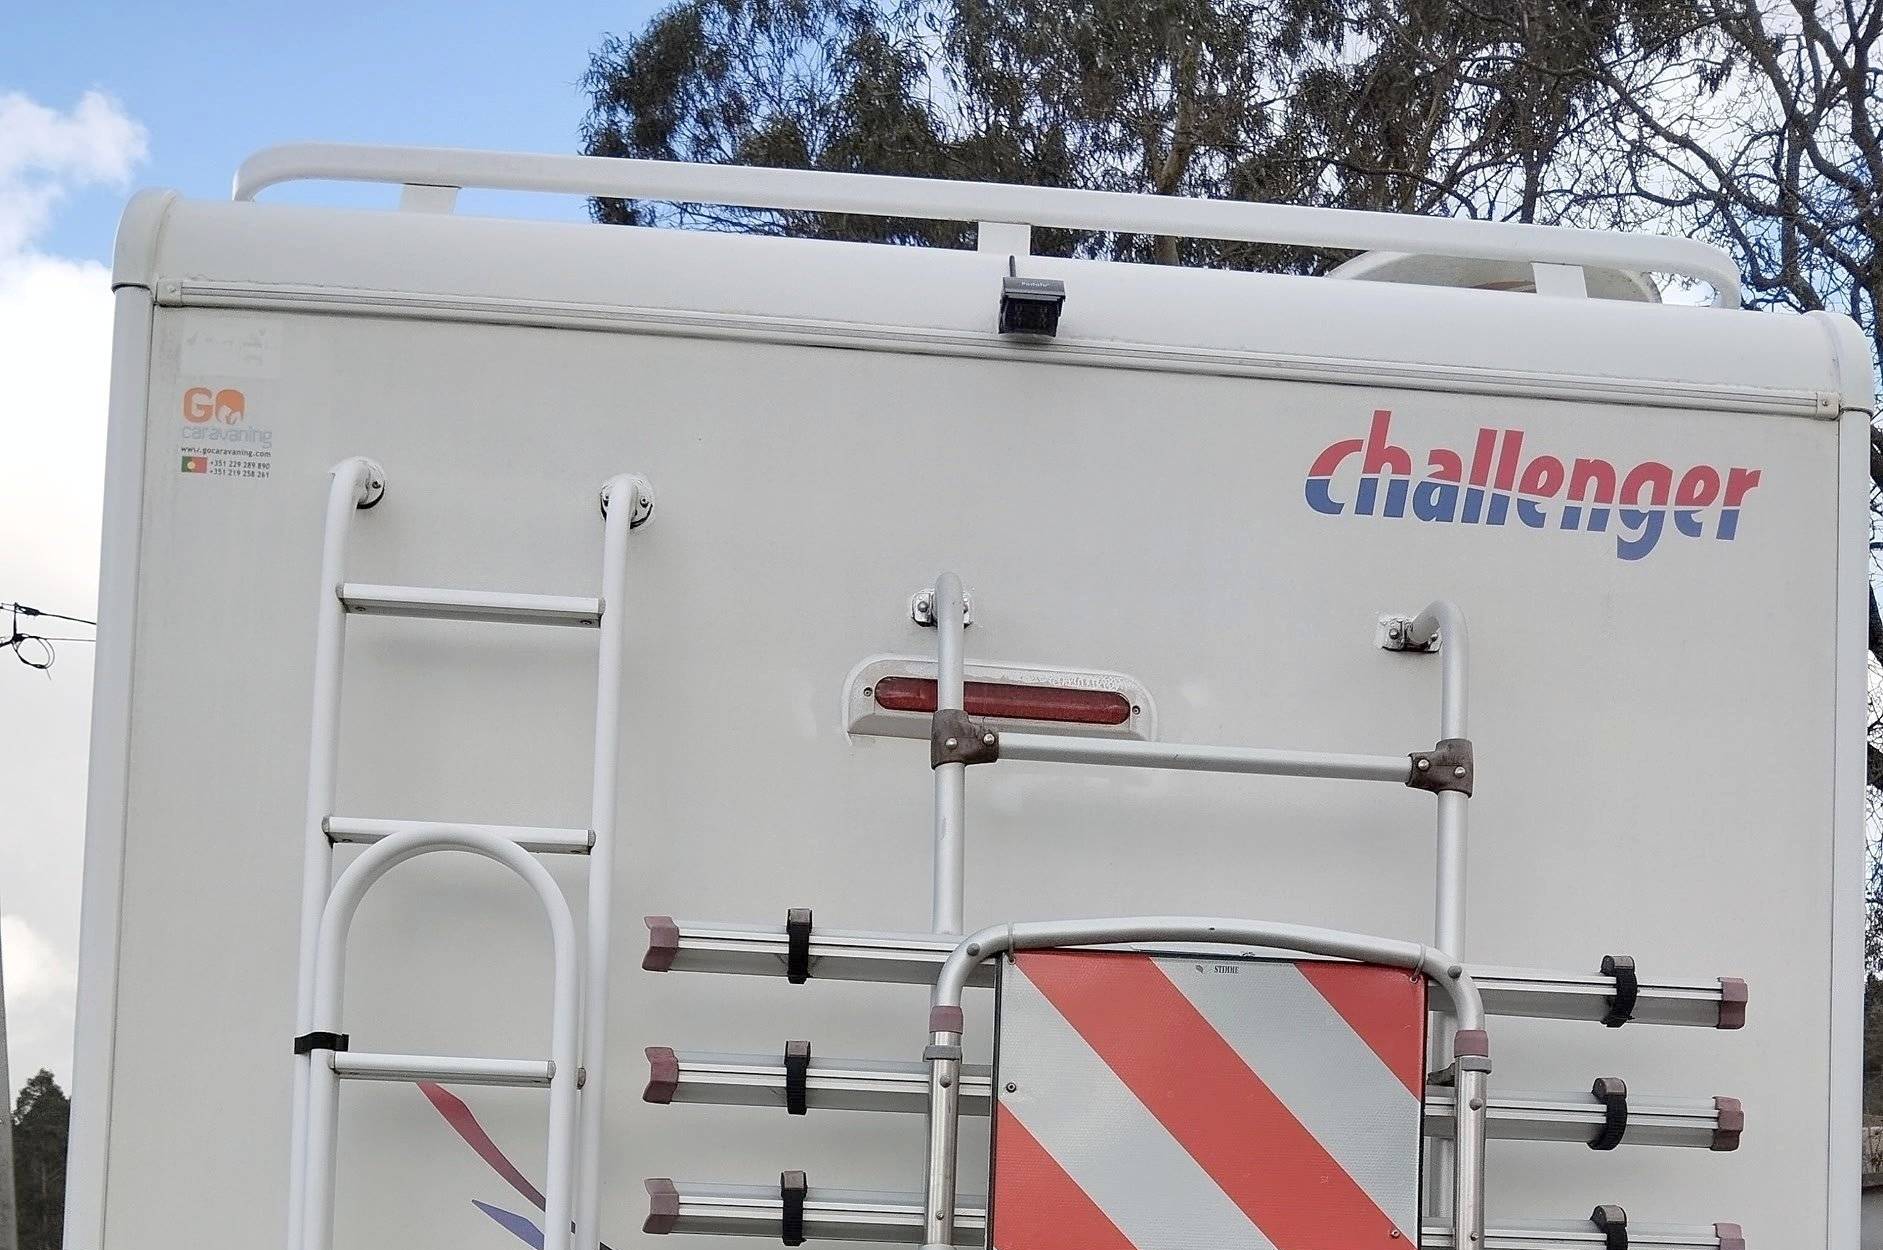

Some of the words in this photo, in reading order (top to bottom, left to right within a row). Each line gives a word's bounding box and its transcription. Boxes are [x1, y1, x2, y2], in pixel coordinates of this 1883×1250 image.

[182, 425, 272, 449] caravaning
[180, 446, 272, 458] www.gocaravaning.com
[1304, 409, 1762, 561] challenger
